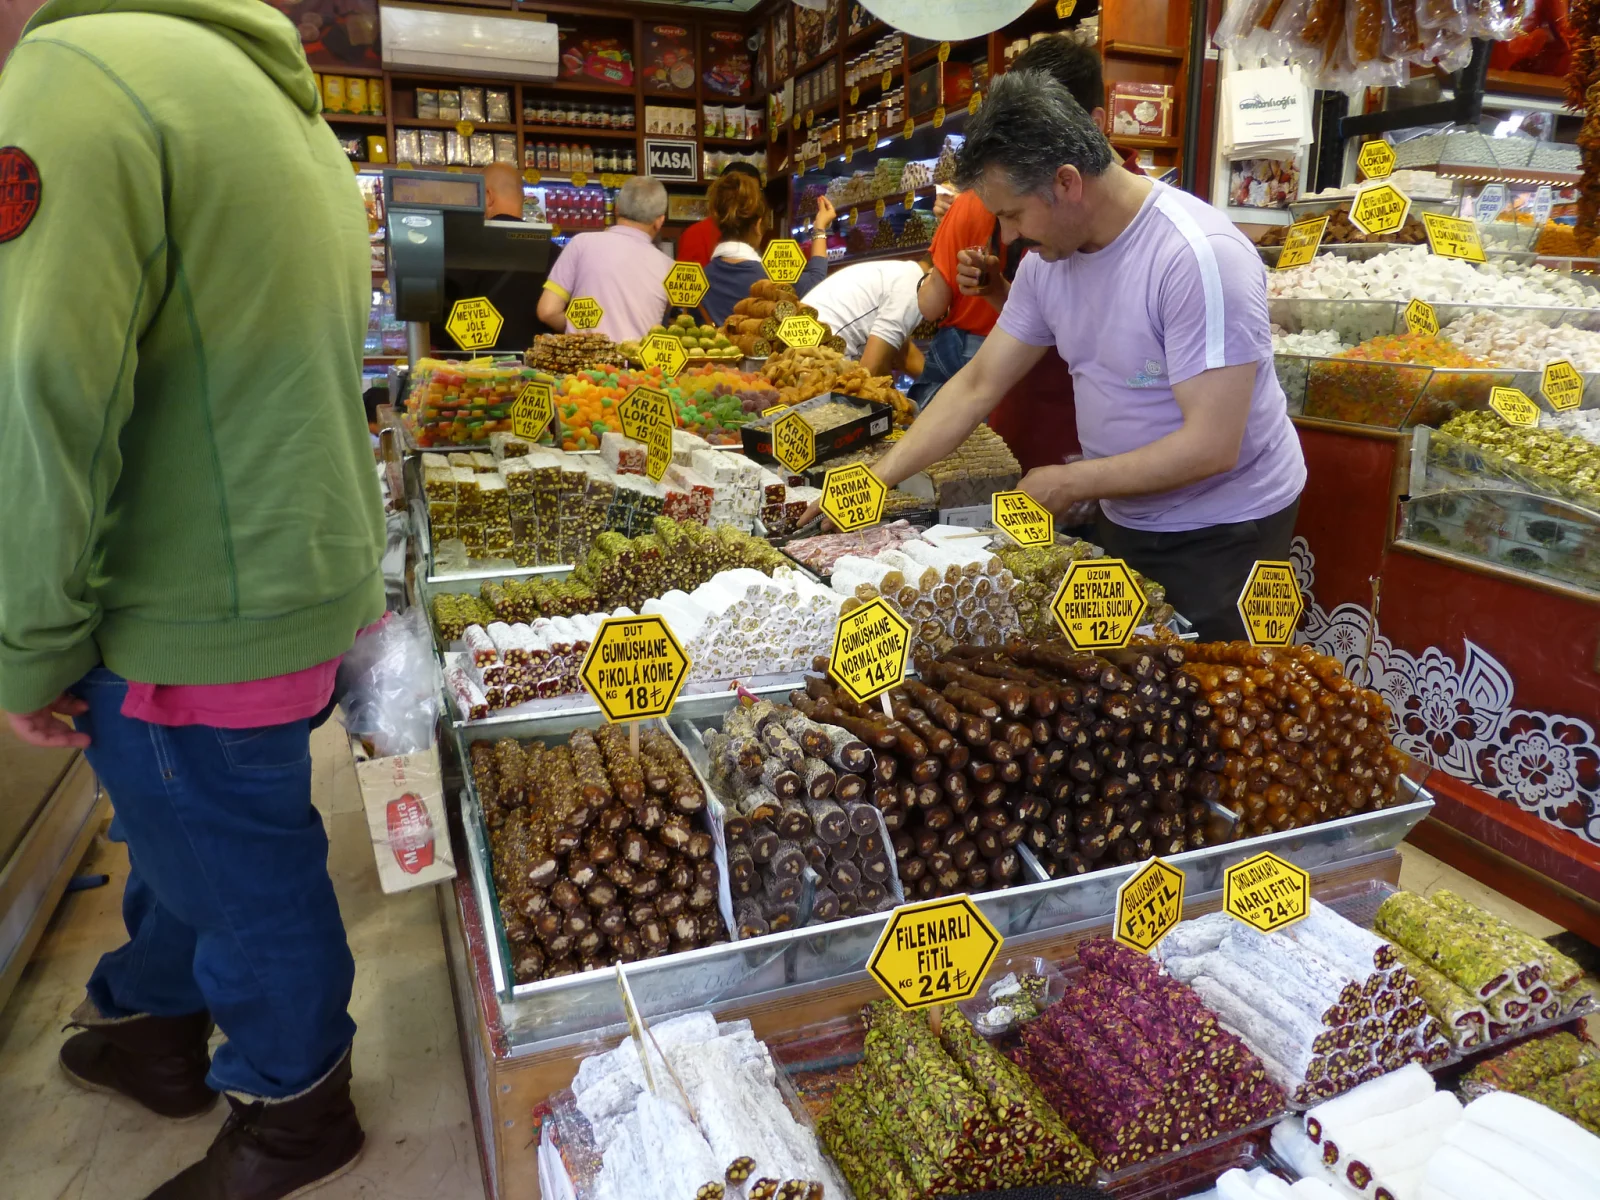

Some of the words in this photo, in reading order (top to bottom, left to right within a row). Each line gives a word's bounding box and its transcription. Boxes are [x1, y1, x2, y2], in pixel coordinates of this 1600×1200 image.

[650, 151, 692, 169] KASA
[1363, 154, 1391, 167] LOKUM
[1360, 202, 1401, 221] LOKUMLARI
[1432, 229, 1477, 244] LOKUMLARI
[774, 250, 793, 259] BURMA
[676, 272, 697, 283] KURU
[668, 281, 702, 292] BAKLAVA
[574, 301, 594, 310] BALLI
[570, 309, 599, 319] KROKANT
[787, 321, 810, 329] ANTEP
[1410, 311, 1435, 333] LOKUMU
[784, 328, 819, 338] MUSKA
[1549, 366, 1571, 381] BALLI
[522, 395, 546, 409] KRAL
[631, 396, 666, 418] KRAL
[1497, 402, 1534, 414] LOKUM
[515, 407, 547, 422] LOKUM
[623, 407, 659, 427] LOKU
[654, 432, 669, 450] KRAL
[785, 420, 809, 449] KRAL
[778, 428, 810, 462] LOKUM
[650, 445, 669, 464] LOKUM
[829, 477, 871, 498] PARMAK
[836, 491, 872, 510] LOKUM
[837, 511, 846, 519] KG
[1000, 510, 1046, 527] BATIRMA
[1086, 569, 1111, 581] ÜZÜM
[1262, 570, 1286, 581] ÜZÜMLÜ
[1073, 581, 1125, 600] BEYPAZARI
[1252, 582, 1271, 598] ADANA
[1106, 600, 1134, 618] SUCUK
[1247, 600, 1275, 617] OSMANLI
[1275, 600, 1296, 617] SUCUK
[854, 612, 869, 627] DUT
[1072, 622, 1083, 631] KG
[623, 625, 644, 637] DUT
[841, 616, 892, 654] GÜMÜŞHANE
[841, 646, 878, 677] NORMAL
[876, 633, 902, 660] KÖME
[642, 660, 674, 684] KÖME
[851, 674, 861, 684] KG
[605, 690, 618, 700] KG
[1234, 887, 1272, 915] NARLI
[1250, 912, 1261, 921] KG
[1136, 929, 1145, 941] KG
[898, 978, 913, 989] KG
